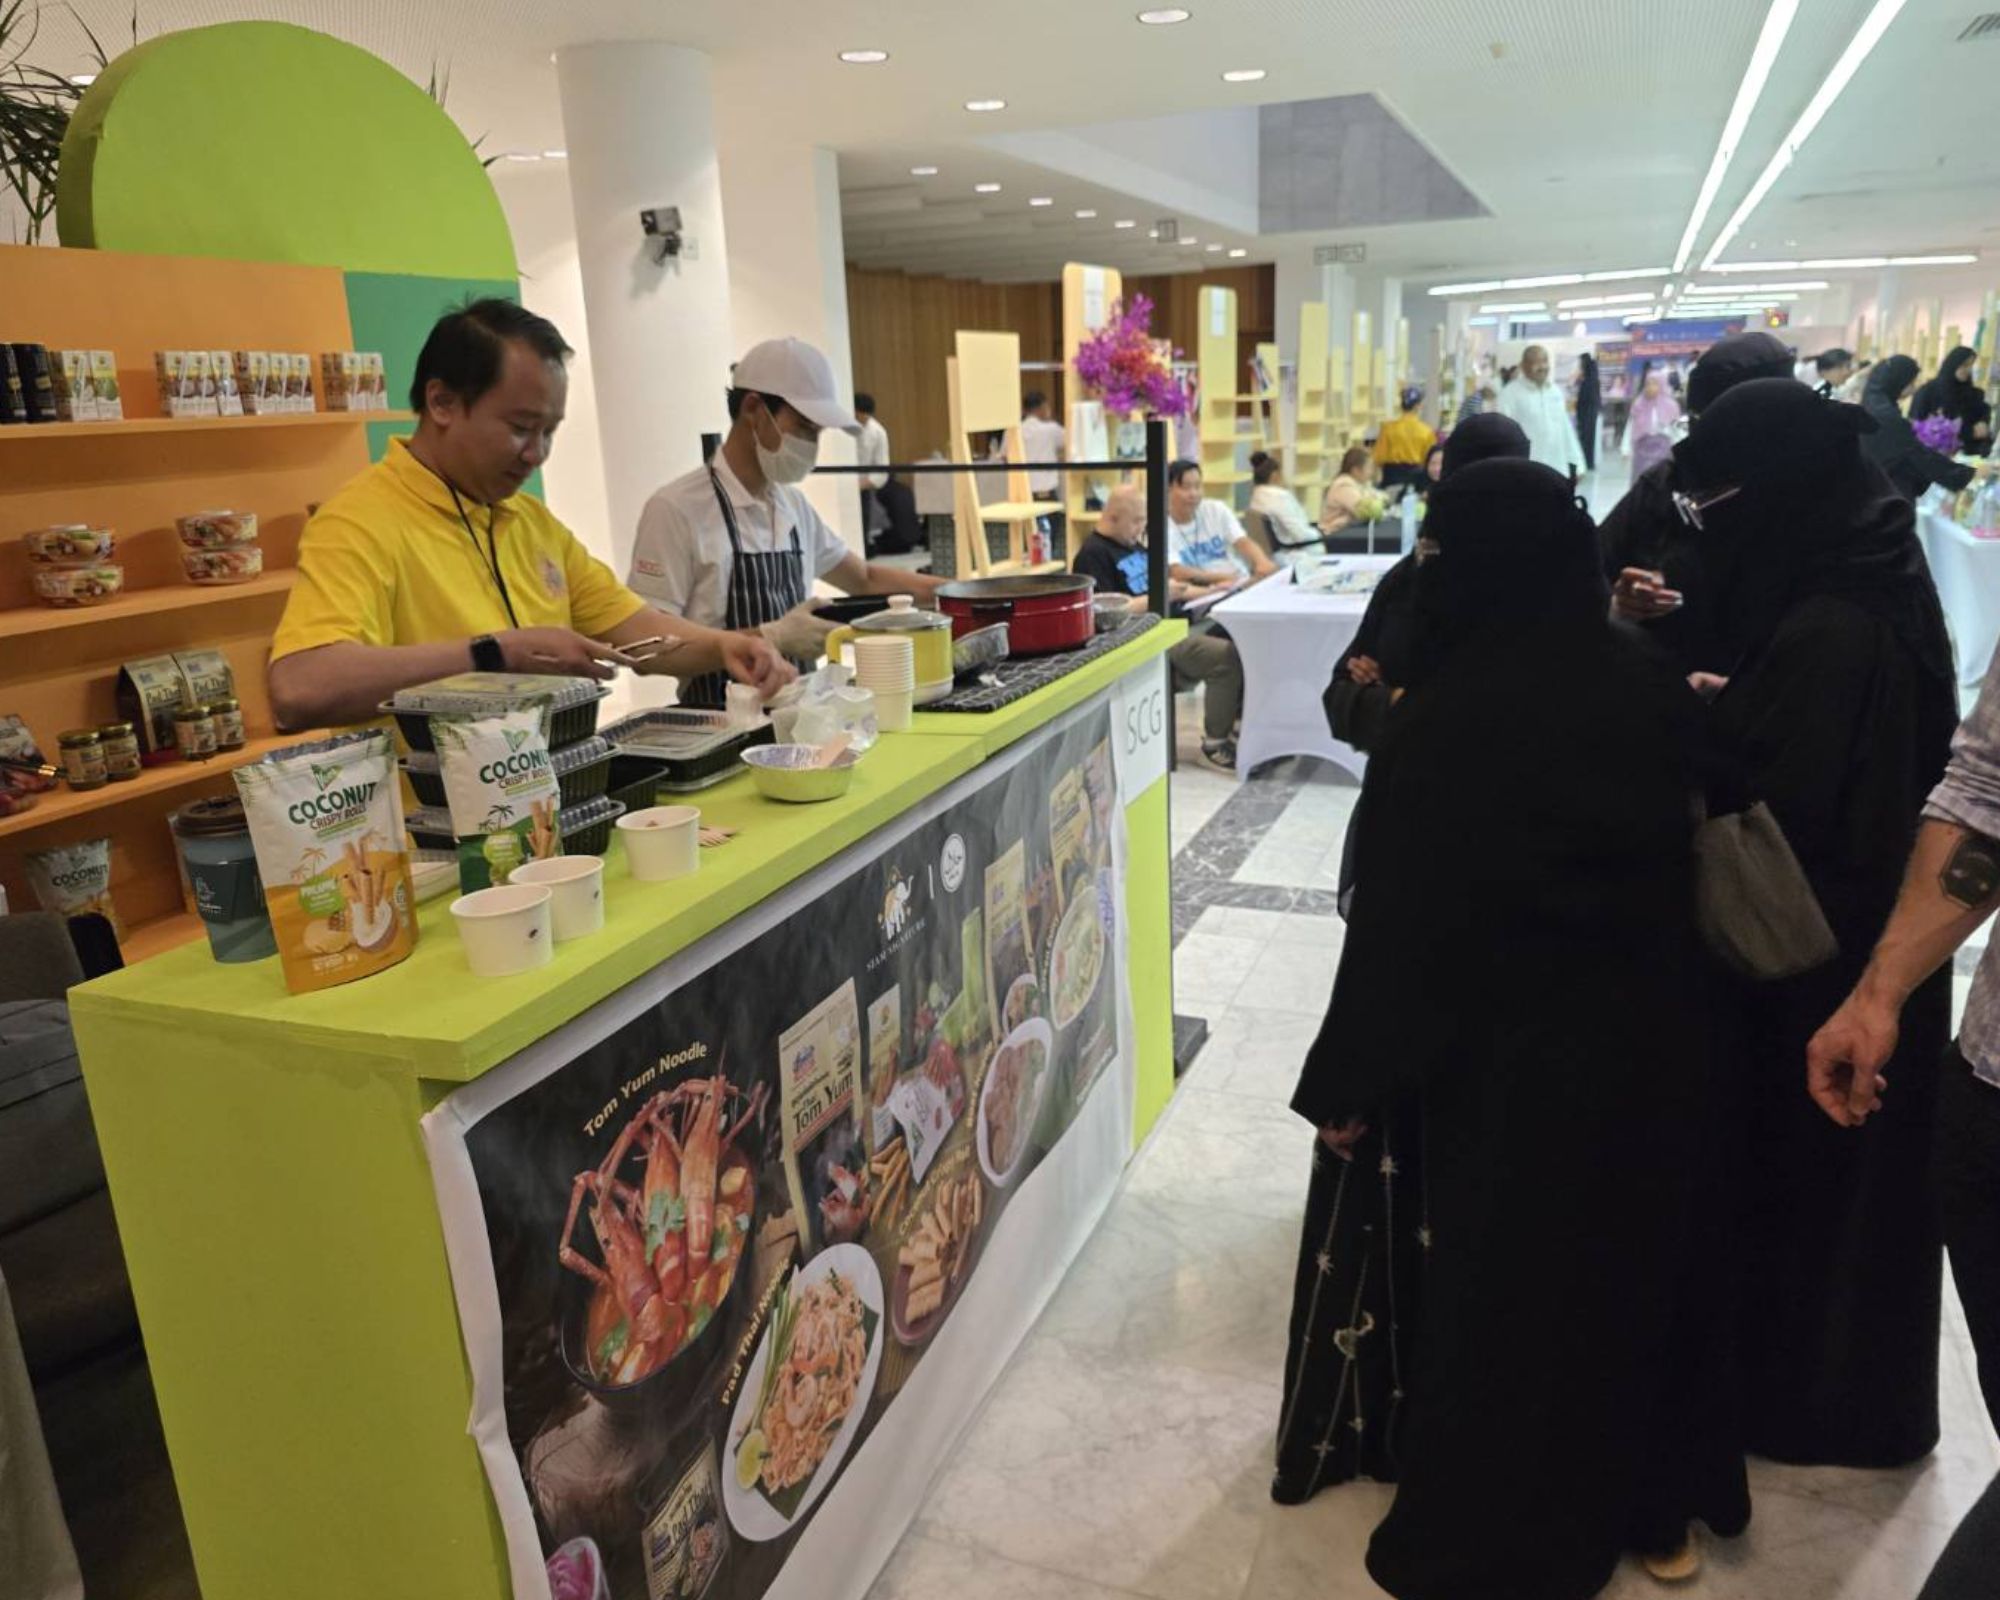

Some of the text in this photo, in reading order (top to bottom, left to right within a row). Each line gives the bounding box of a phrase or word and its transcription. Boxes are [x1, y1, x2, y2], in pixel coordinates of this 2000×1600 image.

[1127, 688, 1162, 756] SCG
[288, 781, 377, 825] COCONUT
[52, 864, 107, 887] COCONUT
[583, 1040, 708, 1137] Tom Yum Noodle
[792, 1100, 822, 1134] Tom
[825, 1071, 854, 1104] Yum
[721, 1362, 742, 1406] Pad
[740, 1311, 761, 1356] Thai
